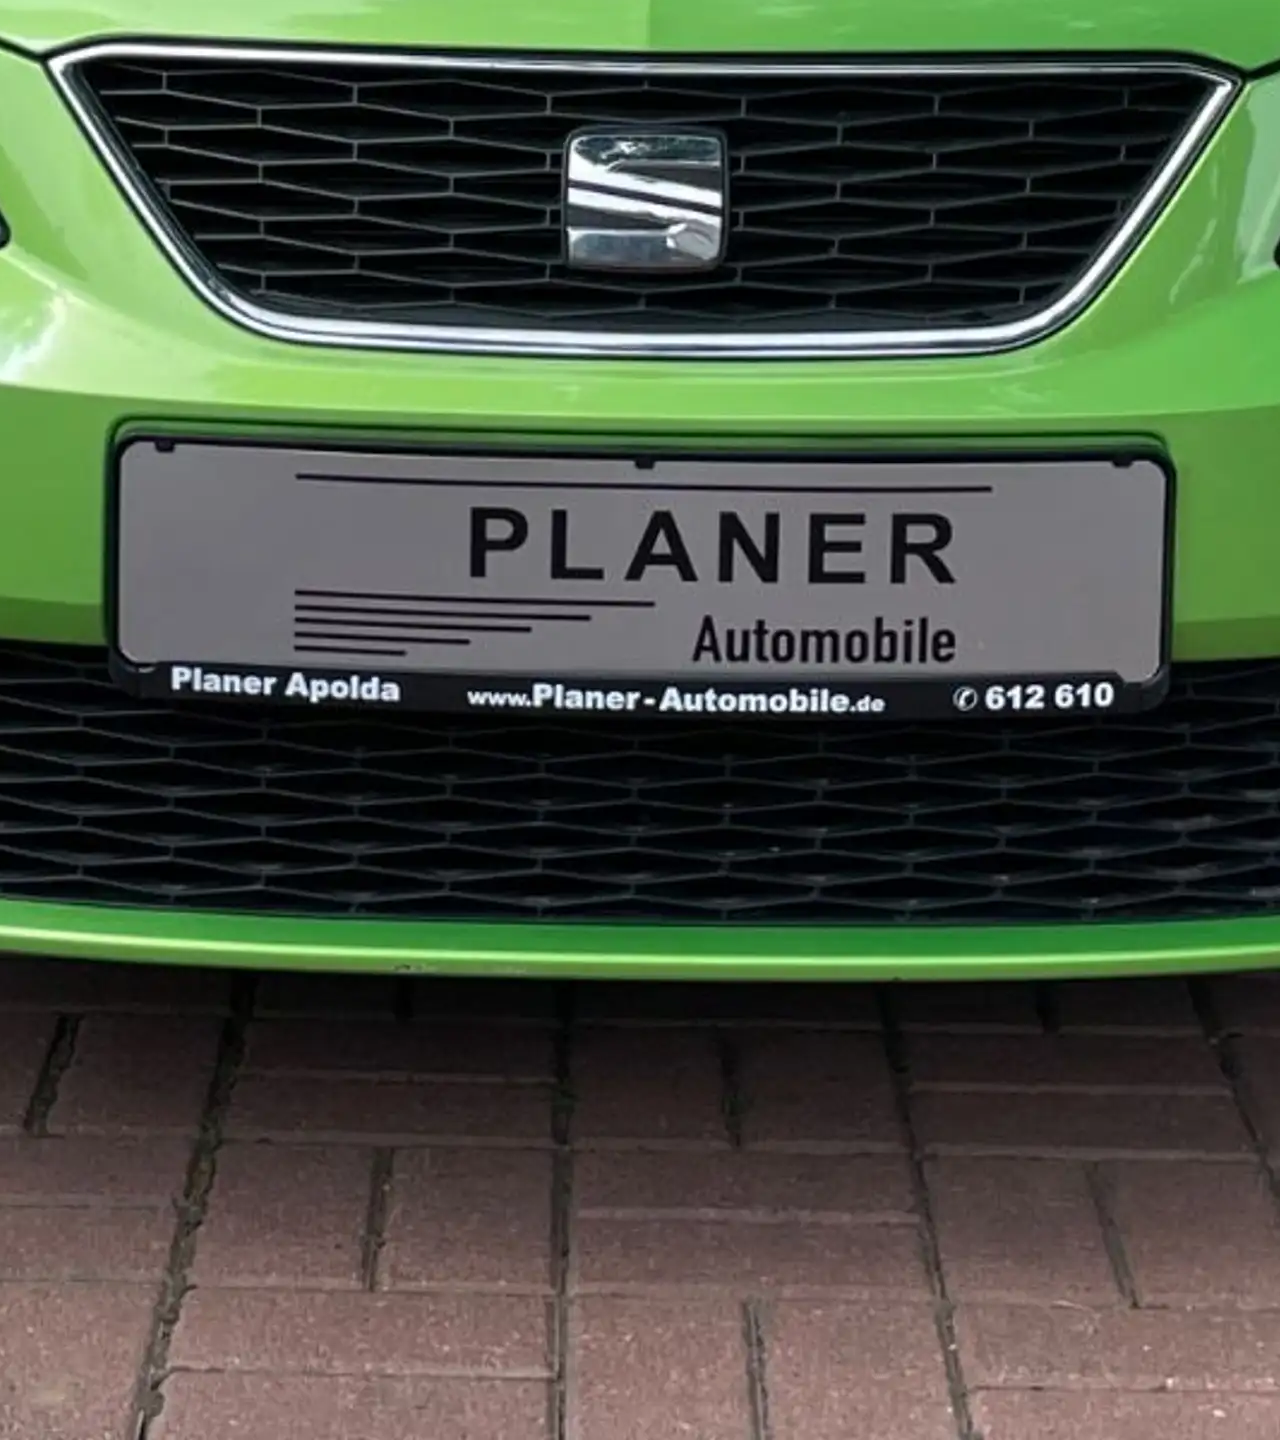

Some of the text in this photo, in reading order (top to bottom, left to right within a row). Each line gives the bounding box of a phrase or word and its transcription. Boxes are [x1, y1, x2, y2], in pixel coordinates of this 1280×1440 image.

[469, 506, 957, 585] PLANER
[691, 614, 956, 664] Automobile
[171, 666, 400, 703] Planer Apolda
[985, 682, 1114, 710] 612 610
